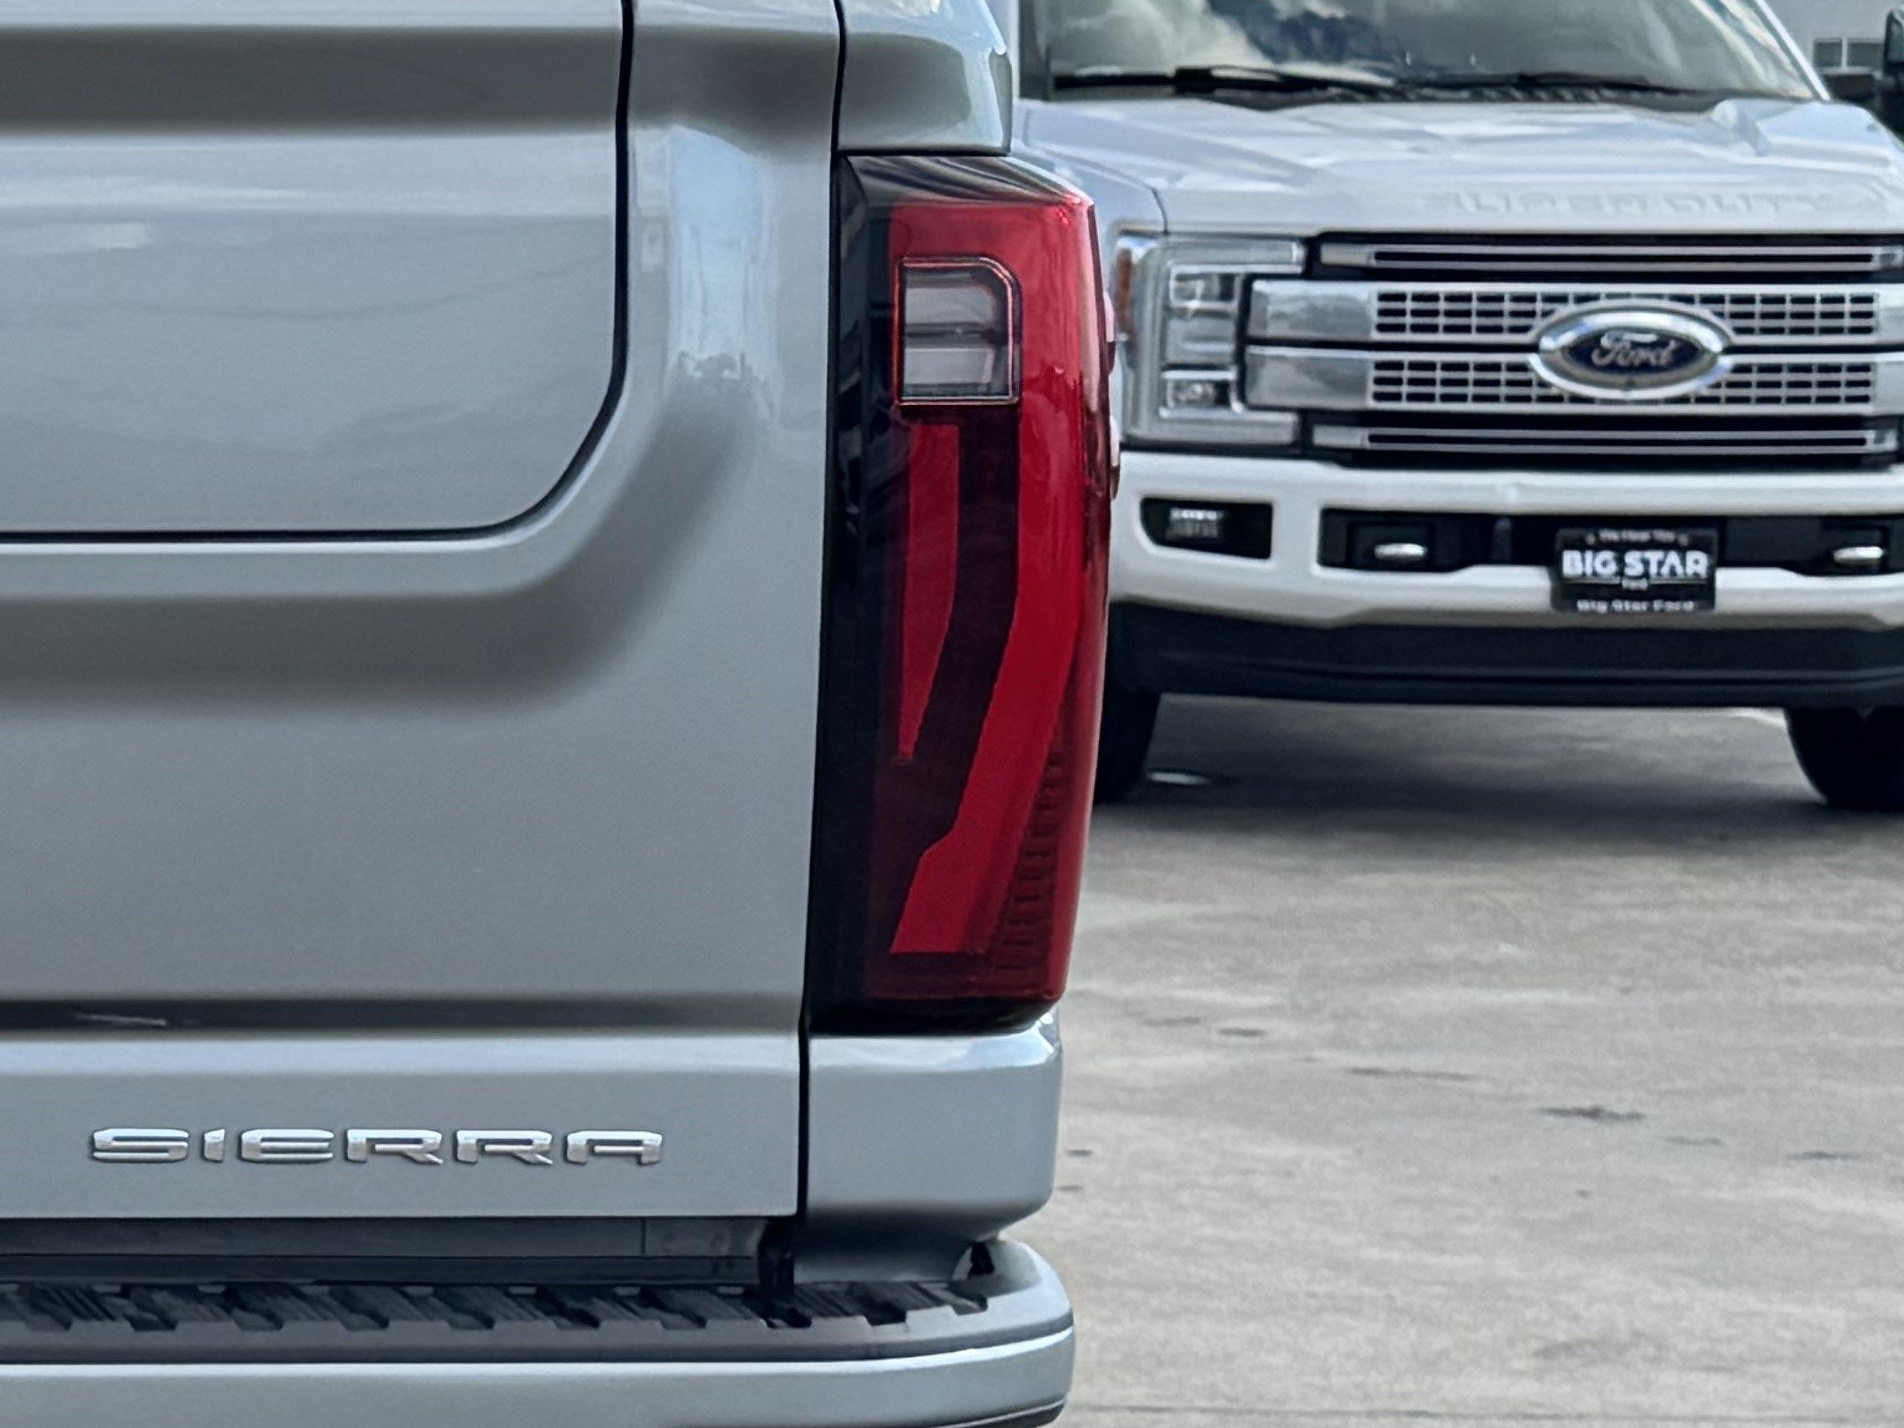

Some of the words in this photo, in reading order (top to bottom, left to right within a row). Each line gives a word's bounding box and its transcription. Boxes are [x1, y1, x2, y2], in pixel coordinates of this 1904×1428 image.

[1591, 331, 1679, 367] Ford
[1562, 549, 1618, 577] BIG
[1623, 549, 1709, 578] STAR
[92, 1127, 663, 1165] SIERRA
